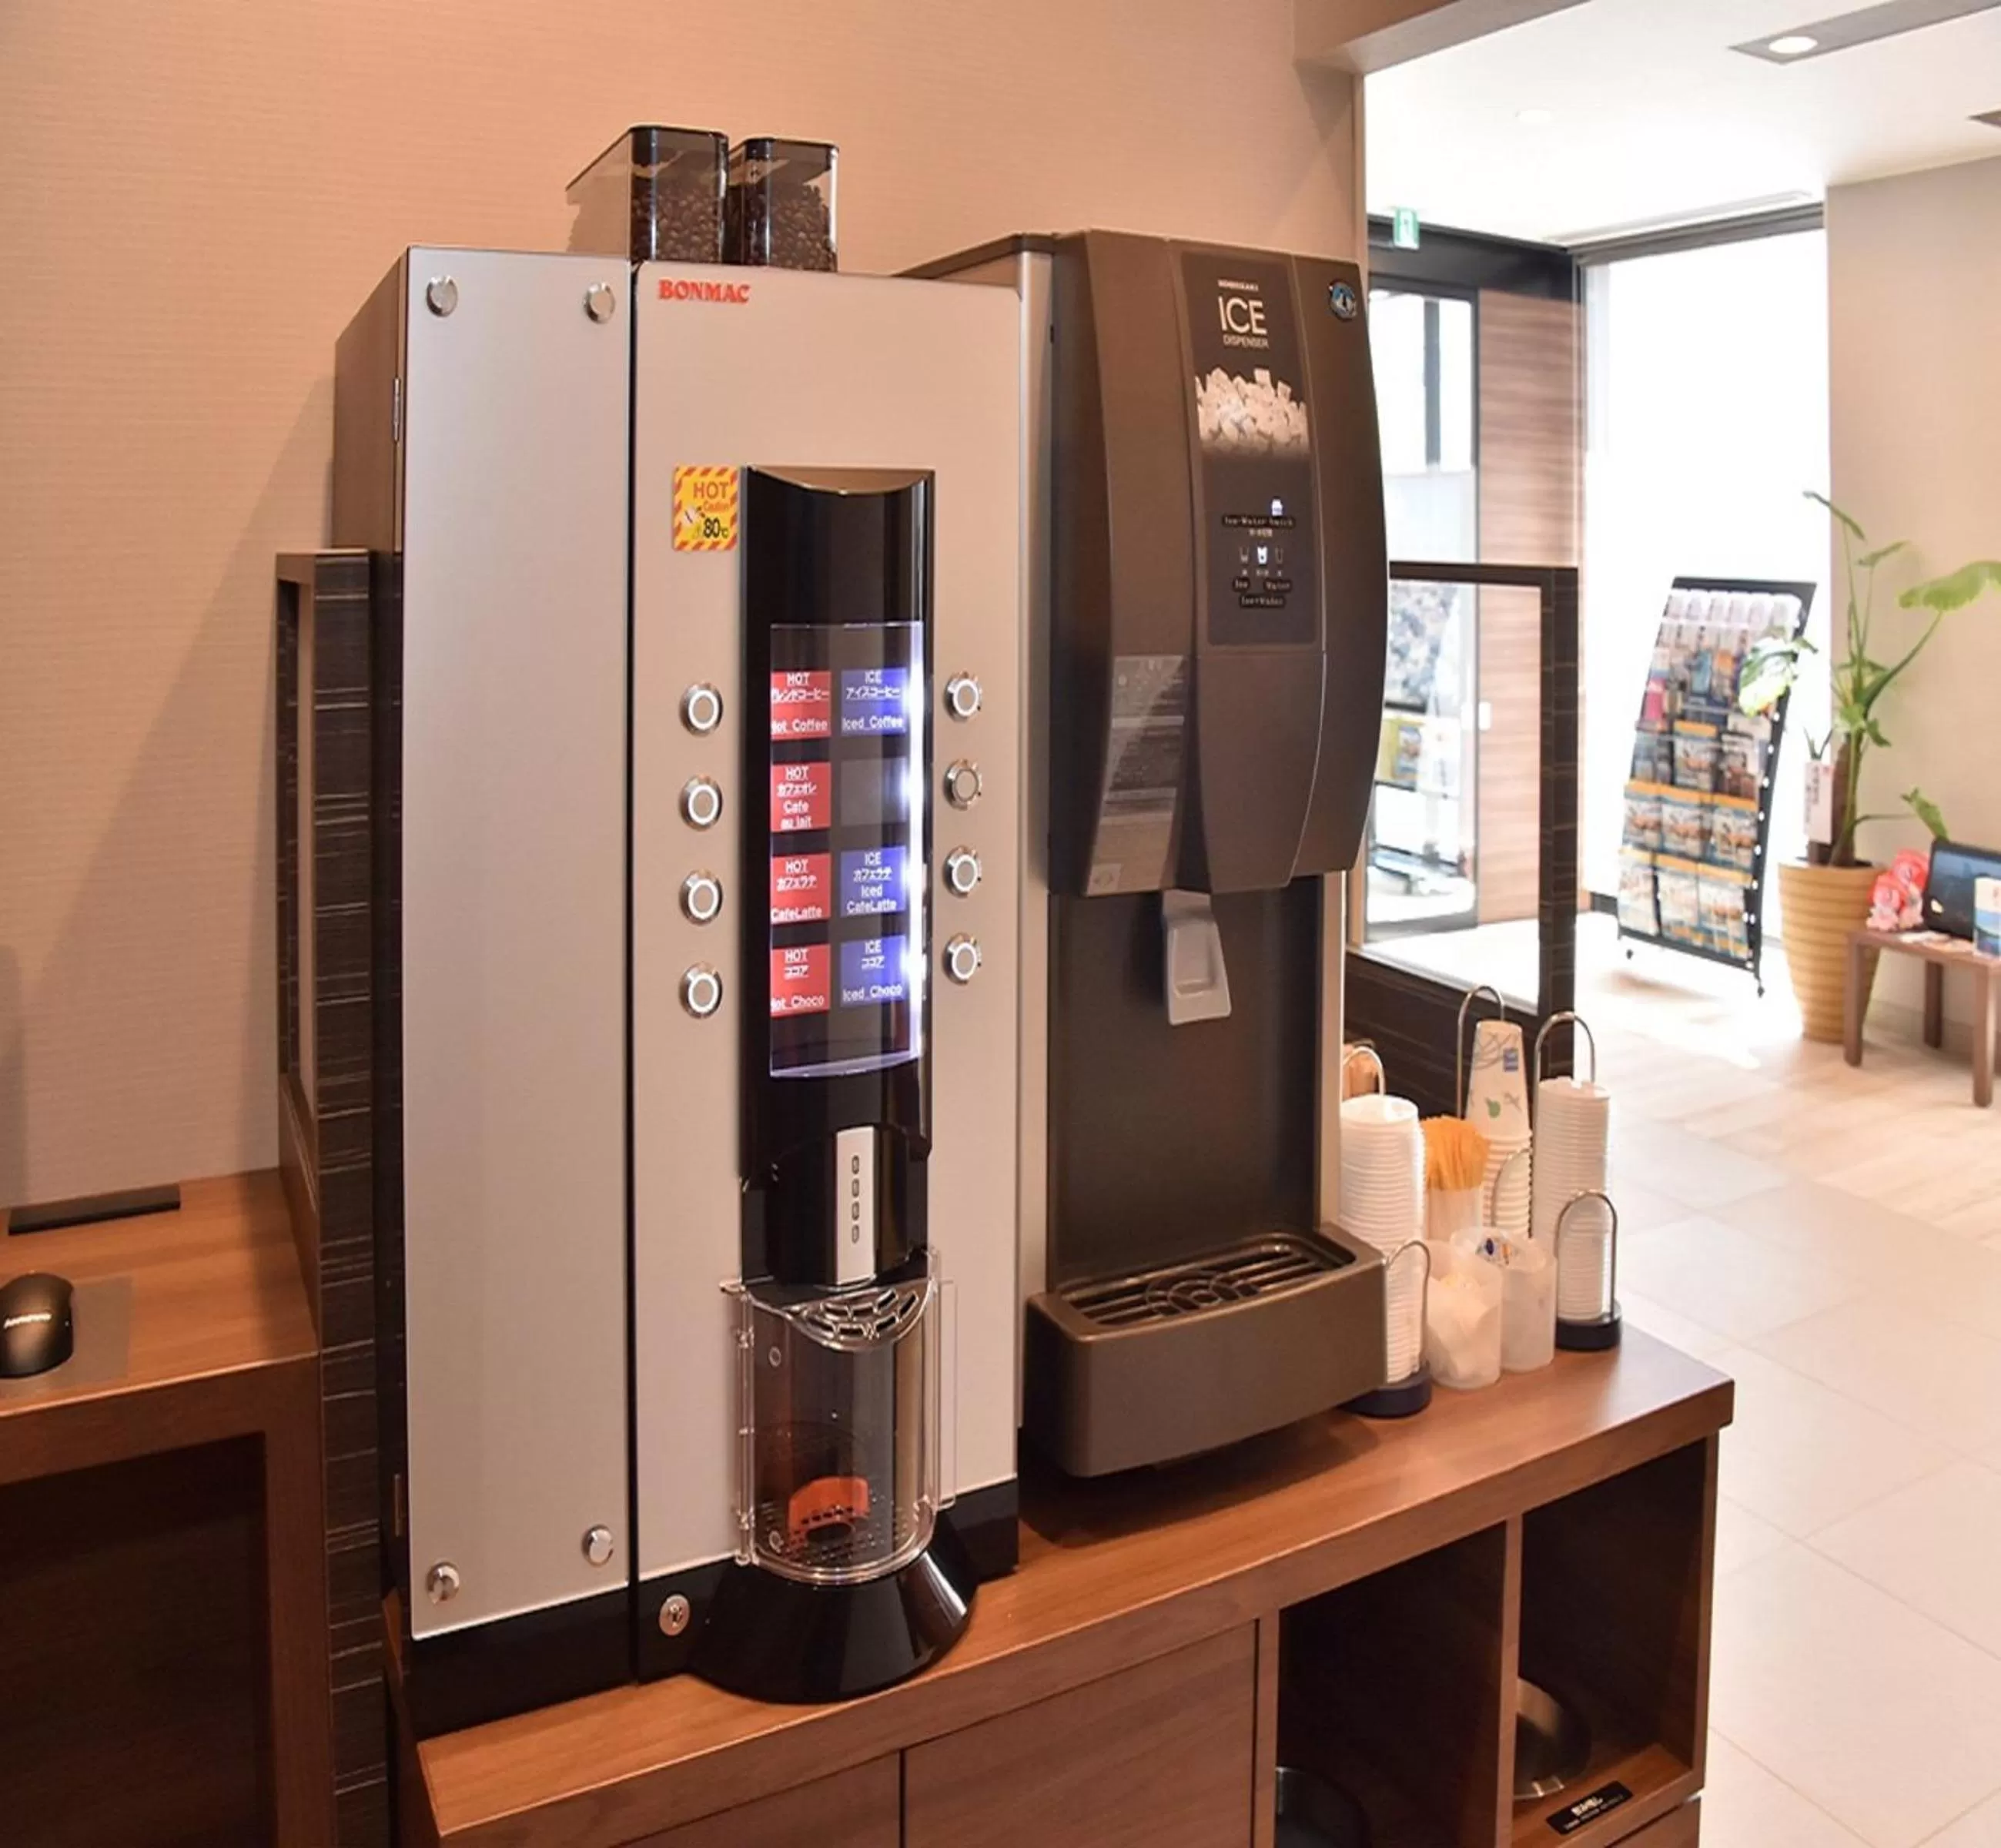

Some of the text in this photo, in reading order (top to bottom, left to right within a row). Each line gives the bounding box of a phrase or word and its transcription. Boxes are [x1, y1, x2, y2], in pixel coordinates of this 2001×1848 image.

[658, 279, 751, 303] BONMAC
[1218, 296, 1268, 334] ICE
[693, 480, 729, 499] HOT
[786, 671, 810, 686] HOT
[865, 670, 883, 684] ICE
[785, 766, 809, 781] HOT
[865, 851, 882, 865] ICE
[785, 859, 809, 874] HOT
[865, 939, 882, 954] ICE
[785, 949, 808, 963] HOT
